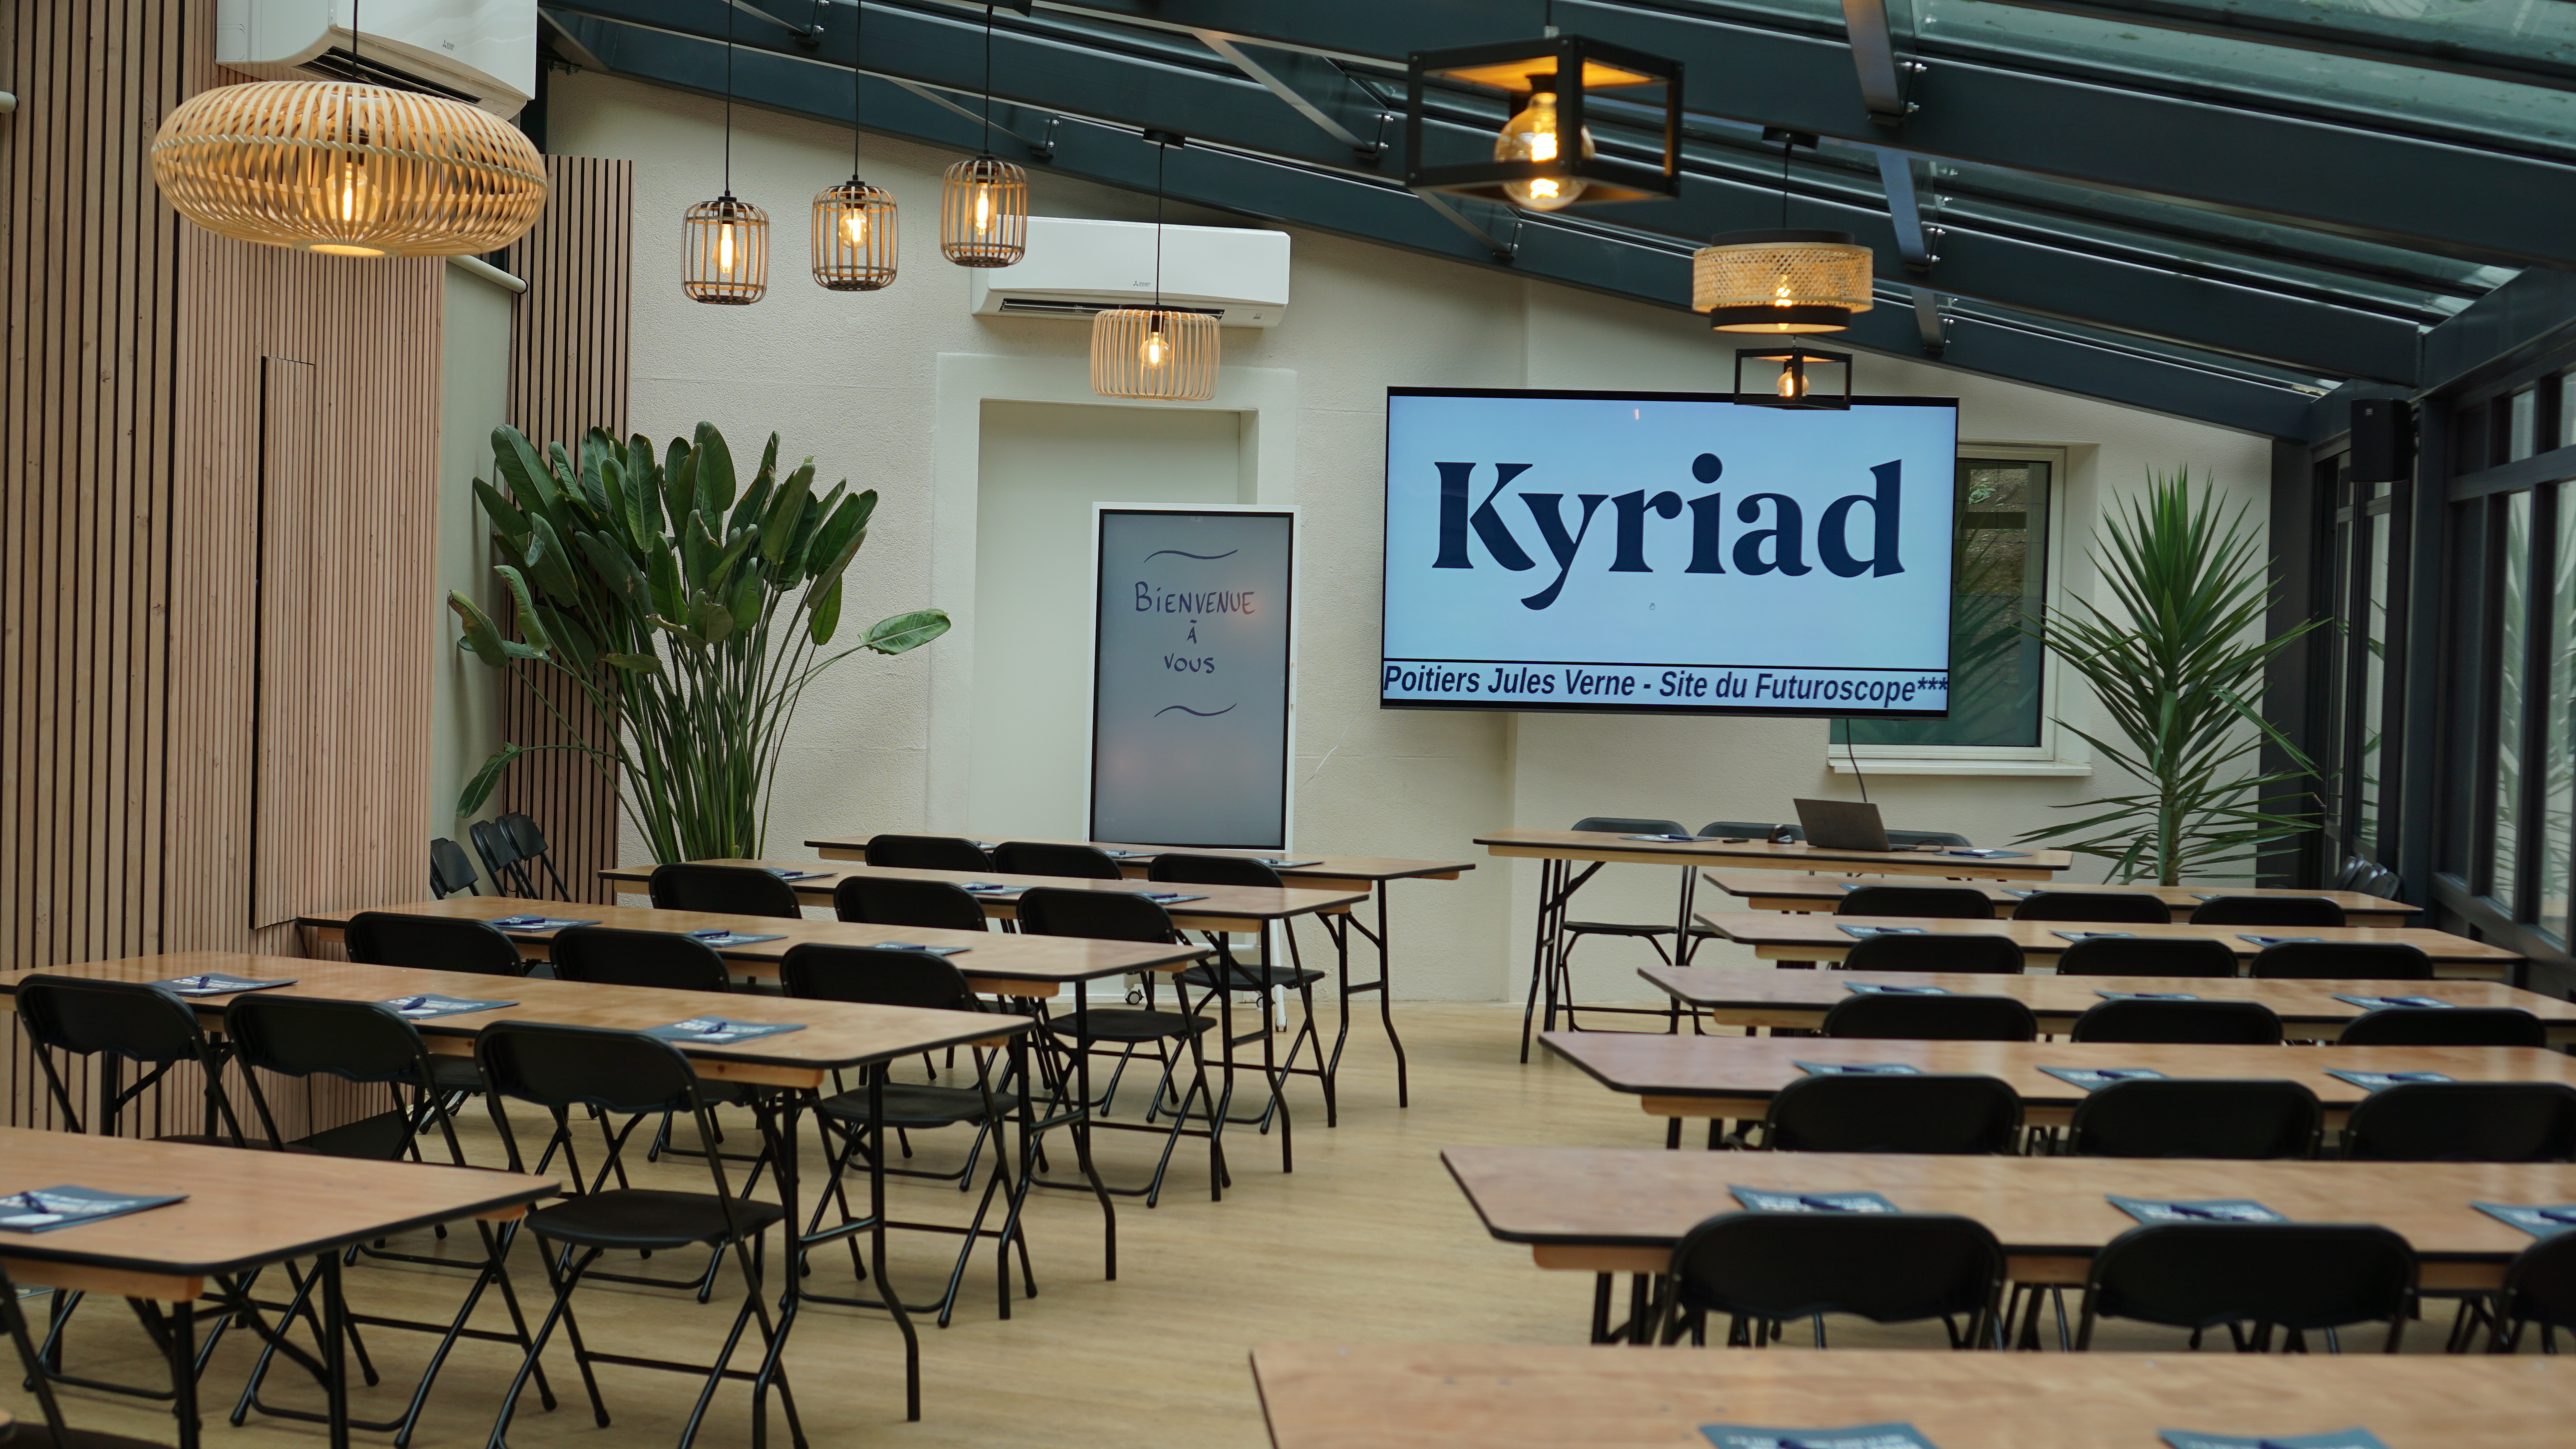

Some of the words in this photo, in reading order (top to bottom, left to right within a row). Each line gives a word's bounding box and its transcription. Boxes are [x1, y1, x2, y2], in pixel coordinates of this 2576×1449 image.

[1431, 452, 1905, 611] Kyriad
[1383, 664, 1480, 692] Poitiers
[1488, 667, 1555, 694] Jules
[1565, 669, 1635, 696] Verne
[1659, 670, 1707, 697] Site
[1716, 671, 1748, 698] du
